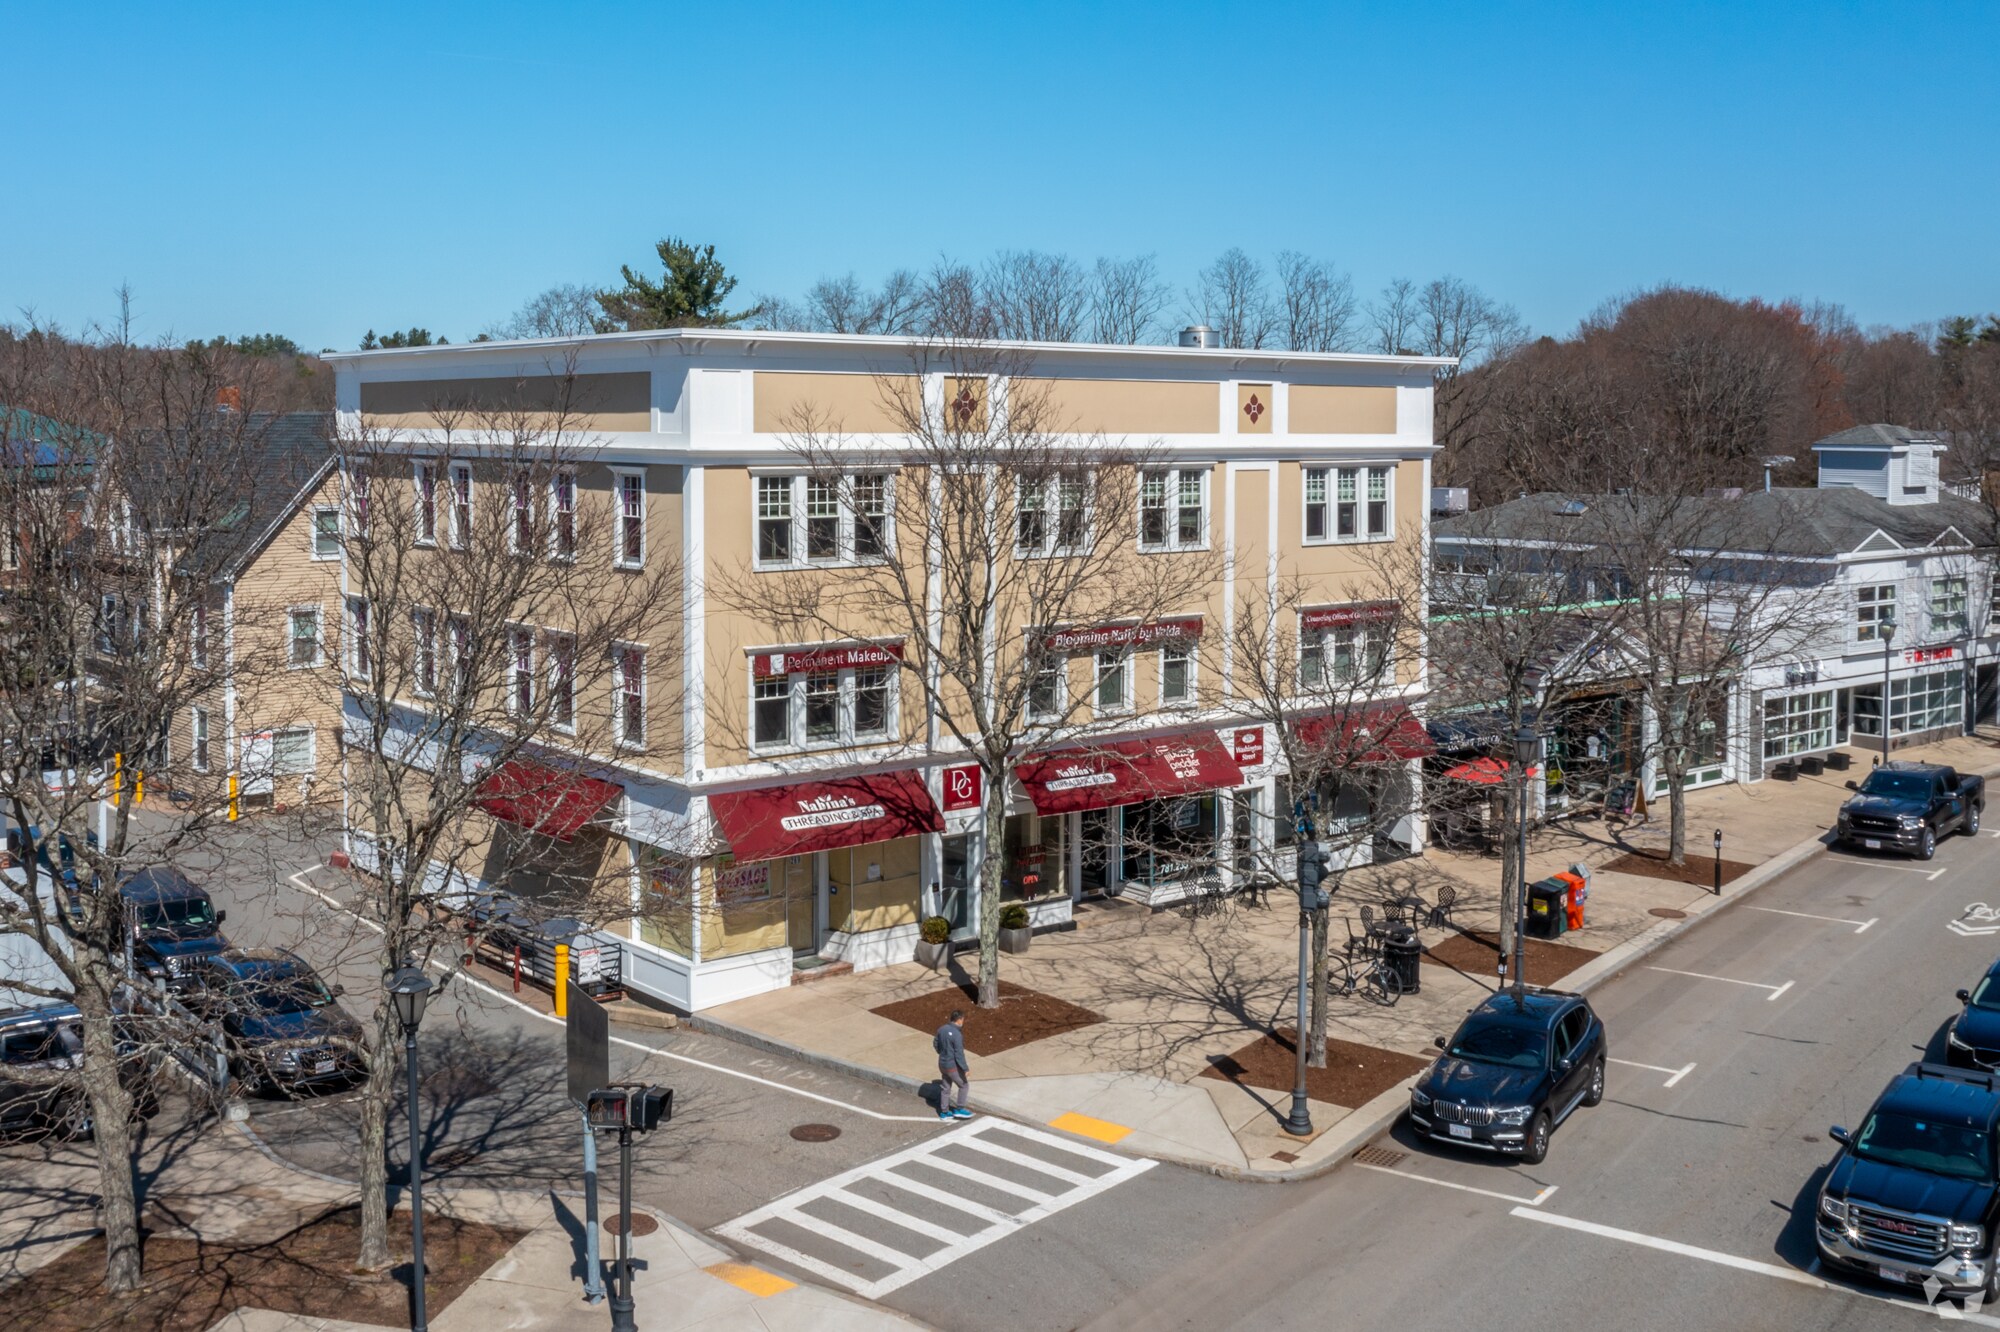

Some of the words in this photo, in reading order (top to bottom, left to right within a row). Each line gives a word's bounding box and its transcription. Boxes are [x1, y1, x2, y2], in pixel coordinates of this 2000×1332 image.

[1055, 631, 1108, 646] Blooming
[1111, 629, 1136, 641] Nails
[1139, 629, 1152, 640] by
[787, 654, 844, 668] Permanent
[848, 650, 890, 663] Makeup
[1236, 744, 1262, 753] Washington
[1169, 757, 1200, 771] peddler
[1183, 767, 1200, 777] deli
[797, 794, 856, 813] Nabina's
[785, 811, 849, 828] THREADING
[860, 807, 881, 817] SPA
[1023, 874, 1038, 885] OPEN
[1876, 1218, 1917, 1235] GMC
